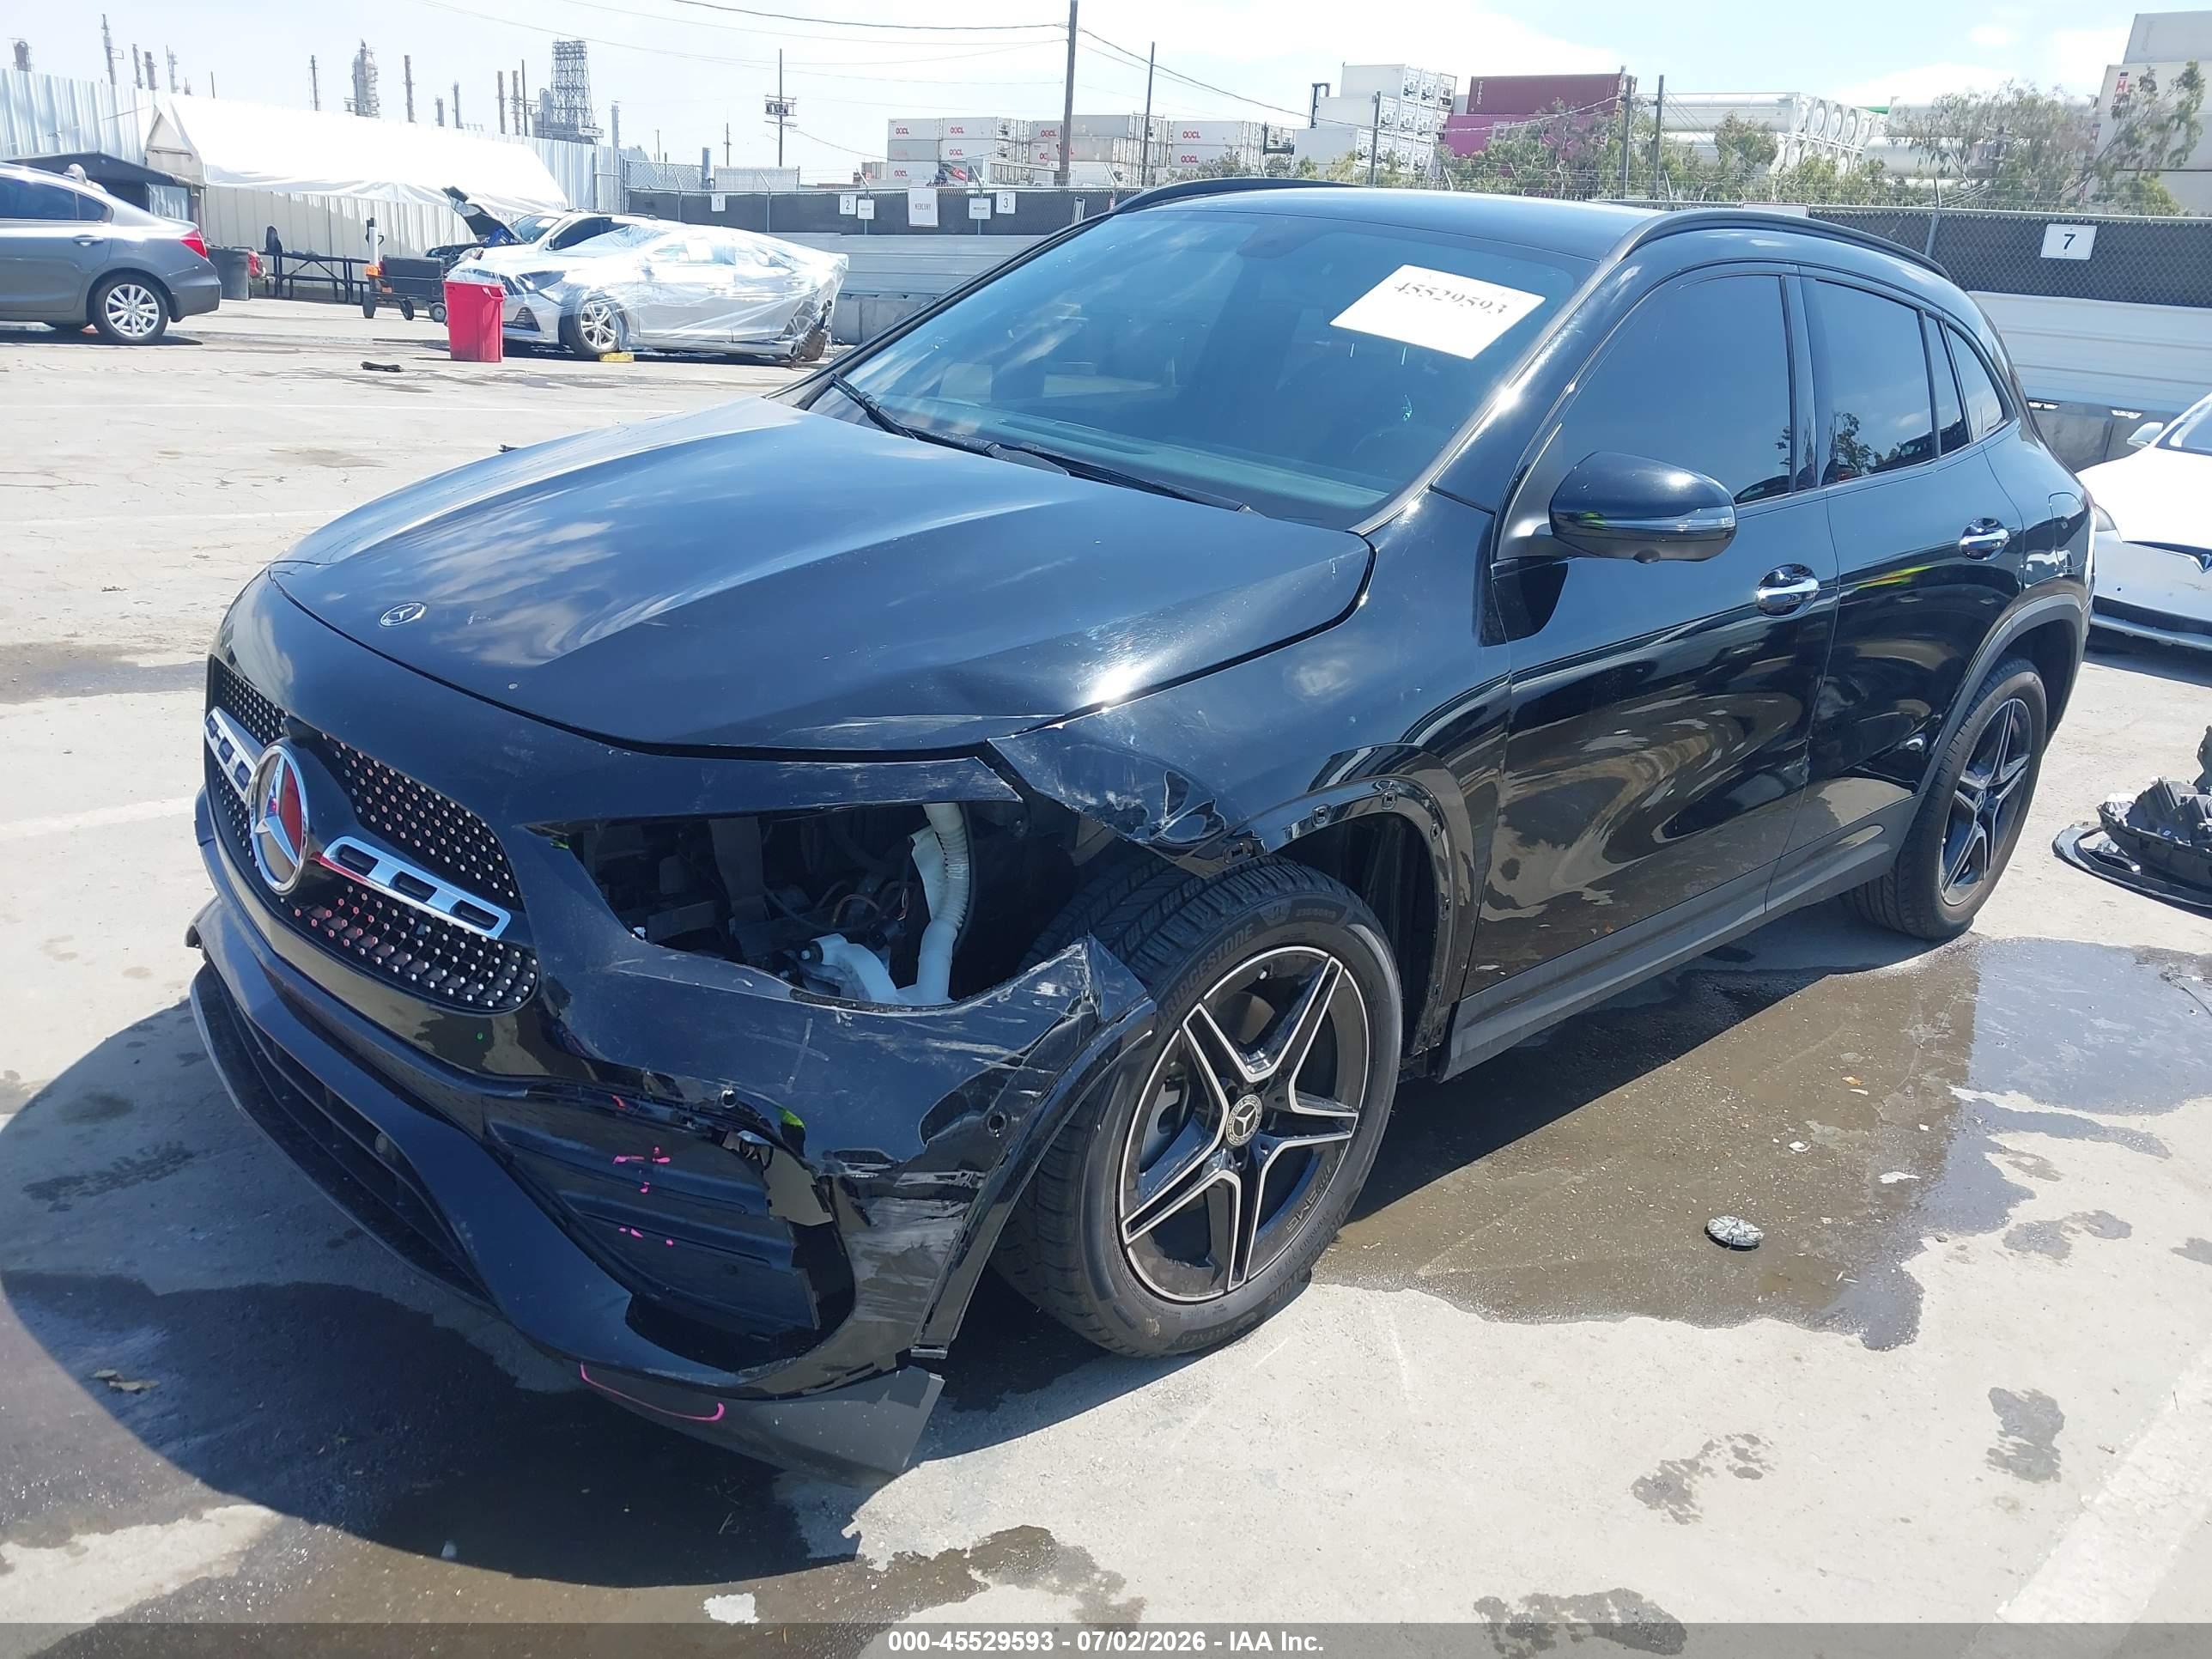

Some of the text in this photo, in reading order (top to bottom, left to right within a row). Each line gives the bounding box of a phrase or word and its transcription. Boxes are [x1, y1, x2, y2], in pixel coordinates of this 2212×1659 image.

[1181, 155, 1199, 163] OOCL
[846, 200, 850, 210] 2
[1003, 198, 1009, 208] 3
[2063, 233, 2076, 250] 7
[1394, 282, 1508, 314] 45529593
